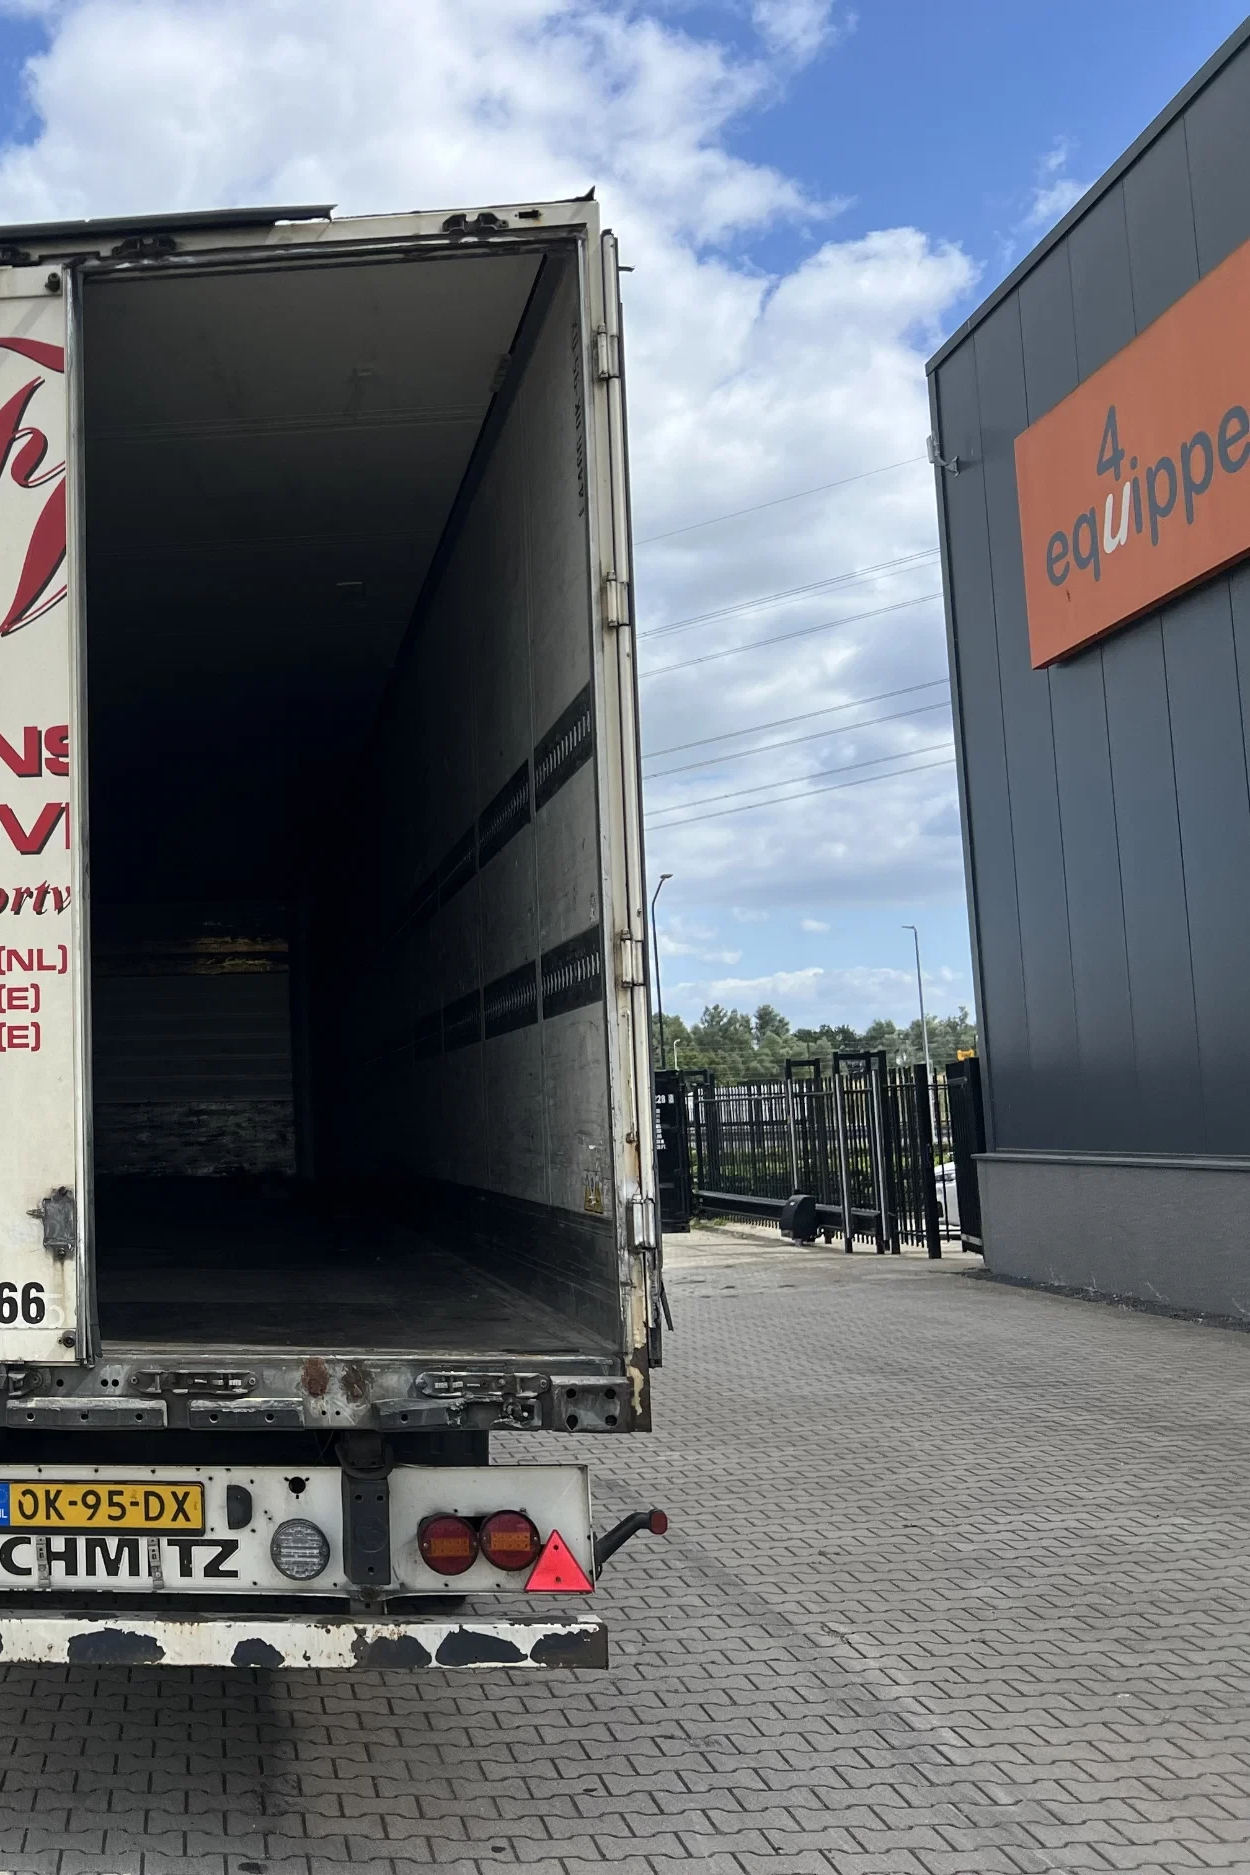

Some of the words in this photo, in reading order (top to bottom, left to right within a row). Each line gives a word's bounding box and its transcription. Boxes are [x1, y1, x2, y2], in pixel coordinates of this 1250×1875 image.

[1096, 405, 1126, 481] 4
[1046, 405, 1250, 586] equippe
[18, 1488, 191, 1522] OK-95-DX
